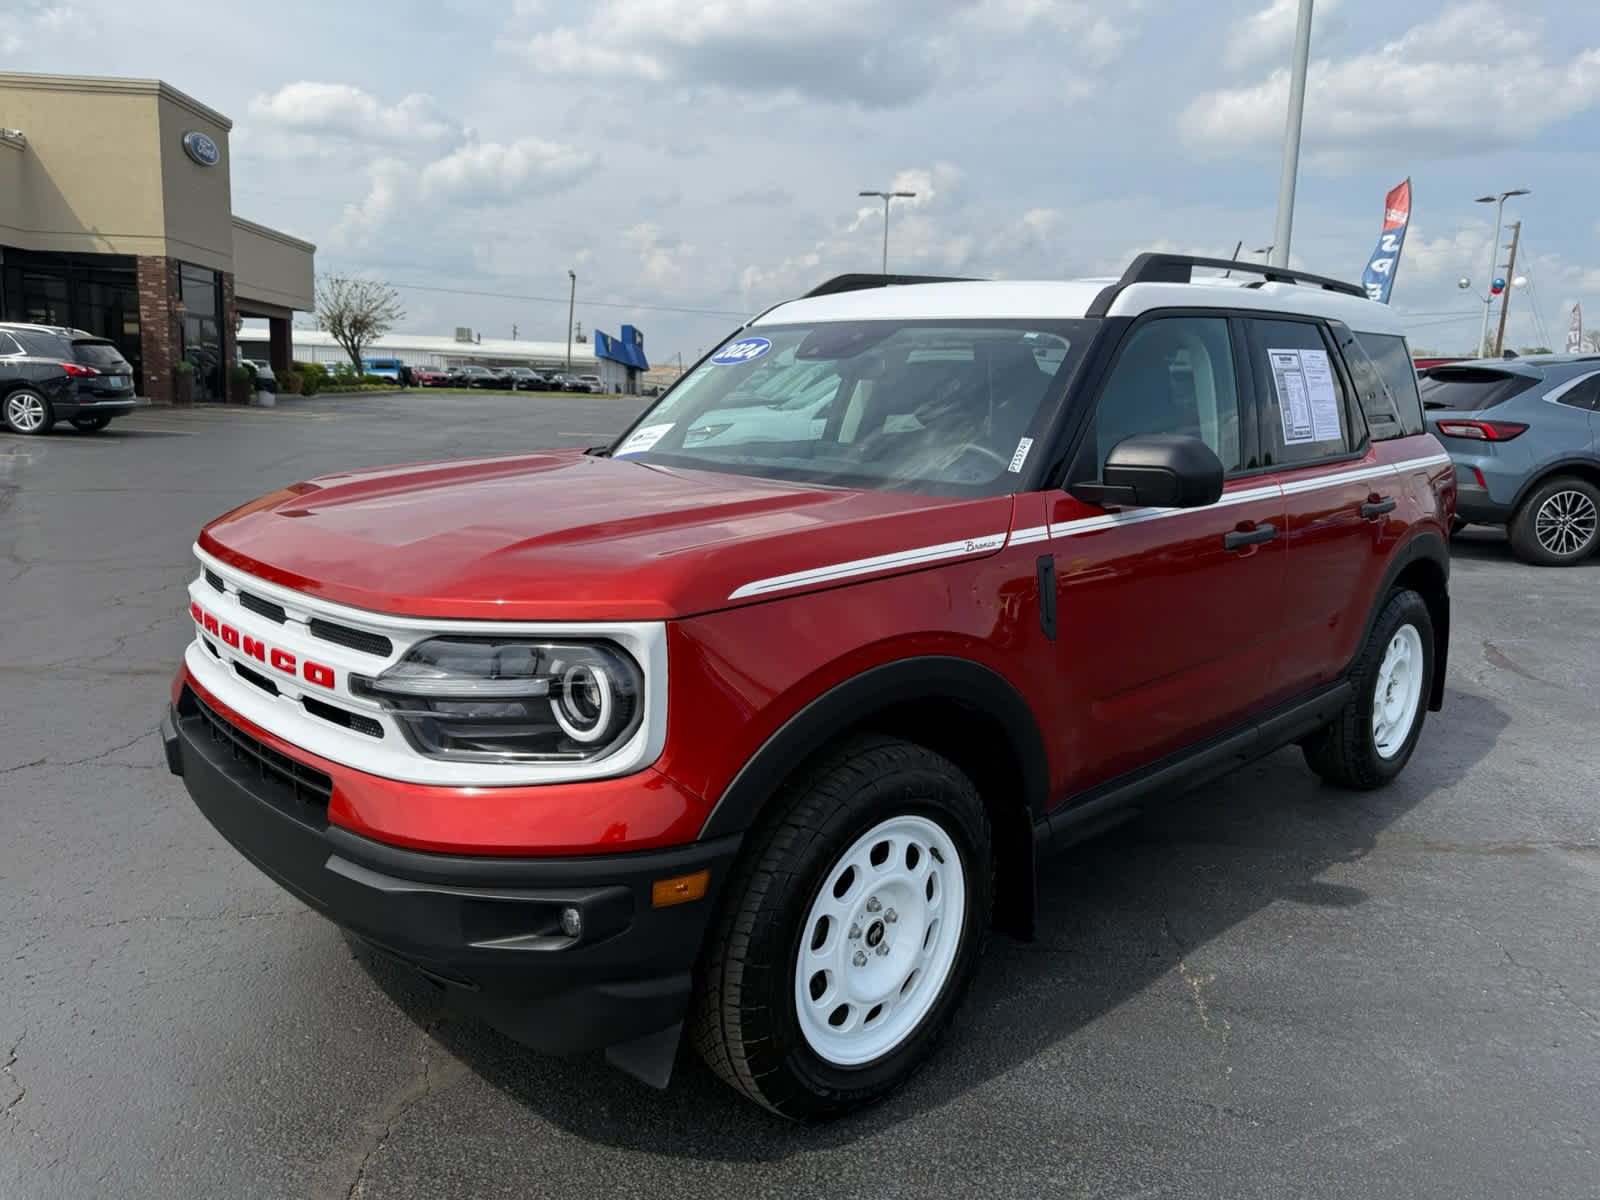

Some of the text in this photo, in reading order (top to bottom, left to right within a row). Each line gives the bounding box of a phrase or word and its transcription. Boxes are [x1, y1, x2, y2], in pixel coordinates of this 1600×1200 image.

[714, 343, 769, 359] 2024
[964, 540, 997, 552] Bronco
[190, 600, 336, 689] BRONCO
